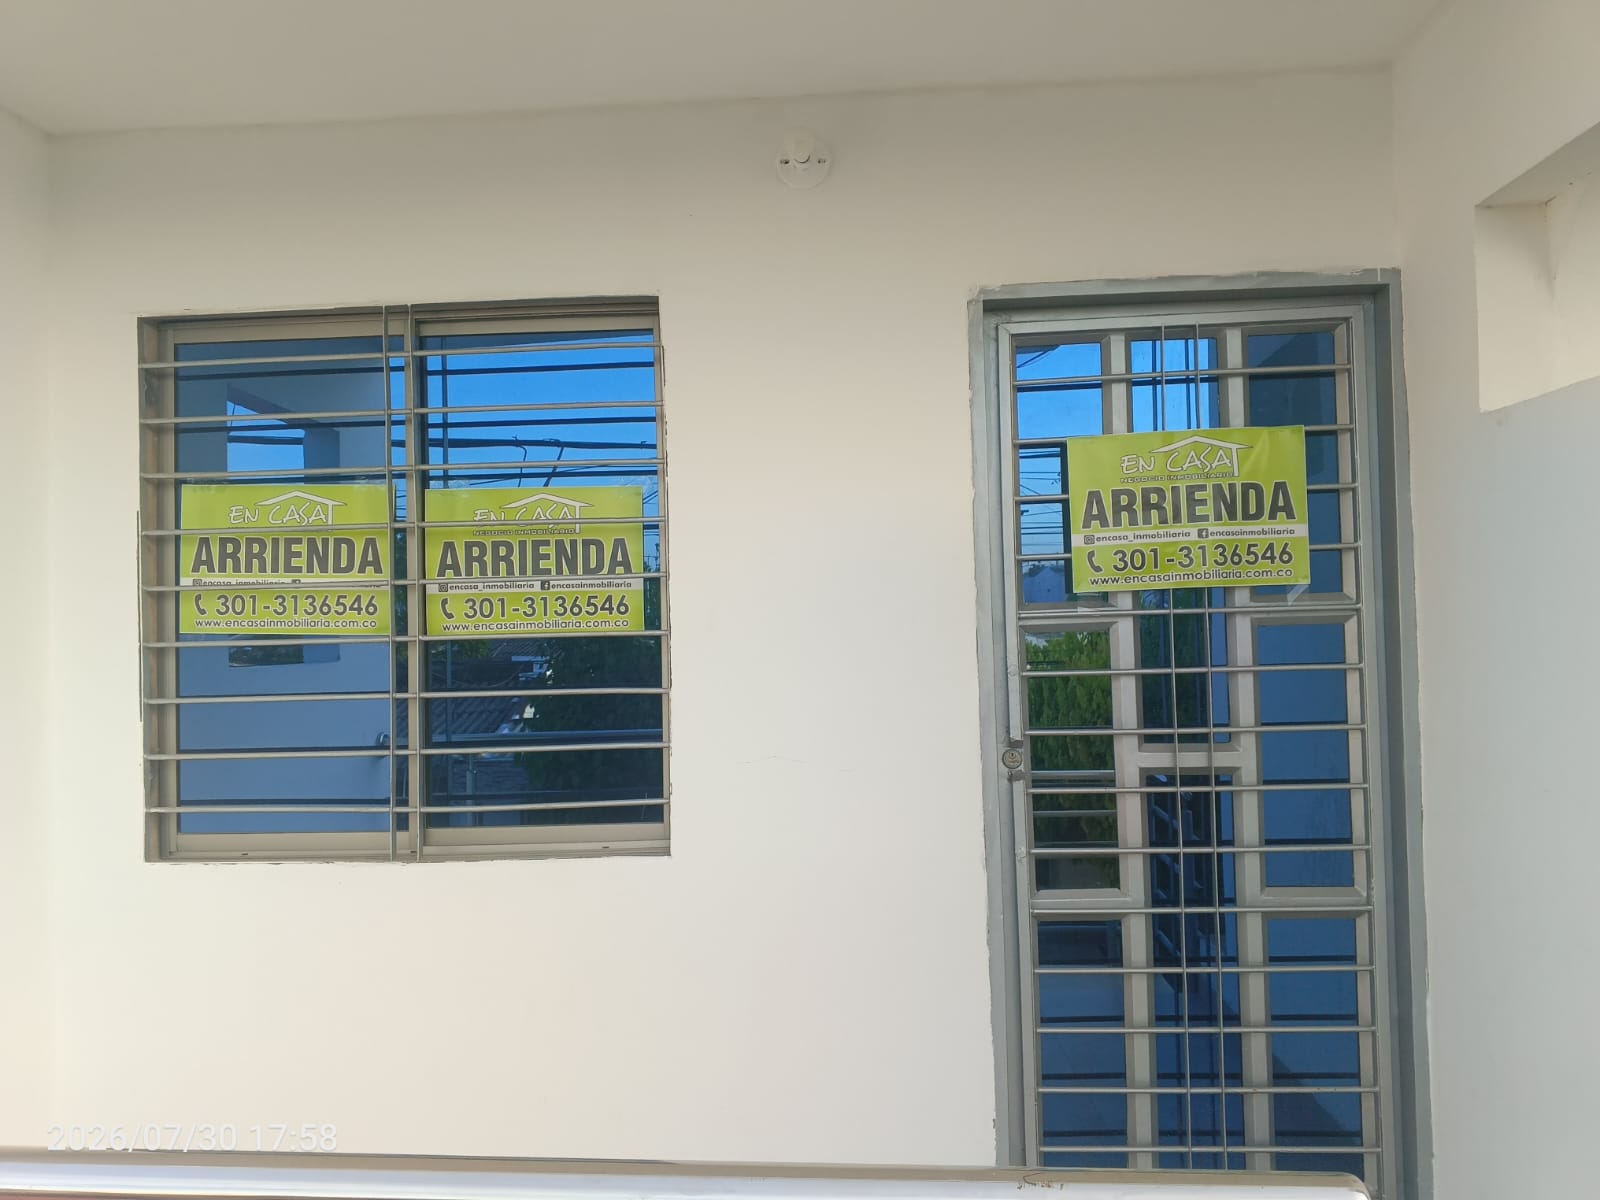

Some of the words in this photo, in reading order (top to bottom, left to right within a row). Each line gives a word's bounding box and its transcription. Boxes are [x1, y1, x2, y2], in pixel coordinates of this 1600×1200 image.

[1121, 454, 1155, 474] EN
[1166, 446, 1232, 473] CASA
[229, 505, 259, 524] EN
[268, 500, 327, 526] CASA
[1081, 480, 1297, 530] ARRIENDA
[1096, 530, 1191, 543] encasa_inmobiliaria
[1209, 528, 1295, 537] encasainmobiliaria
[191, 536, 384, 574] ARRIENDA
[436, 537, 633, 577] ARRIENDA
[1112, 541, 1293, 573] 301-3136546
[449, 582, 535, 591] encasa_inmobiliaria
[551, 580, 632, 590] encasainmobiliaria
[1090, 568, 1293, 586] www.encasainmobiliaria.com.co
[215, 594, 378, 616] 301-3136546
[463, 594, 630, 619] 301-3136546
[195, 618, 377, 629] www.encasainmobiliaria.com.co
[442, 618, 629, 632] www.encasainmobiliaria.com.co
